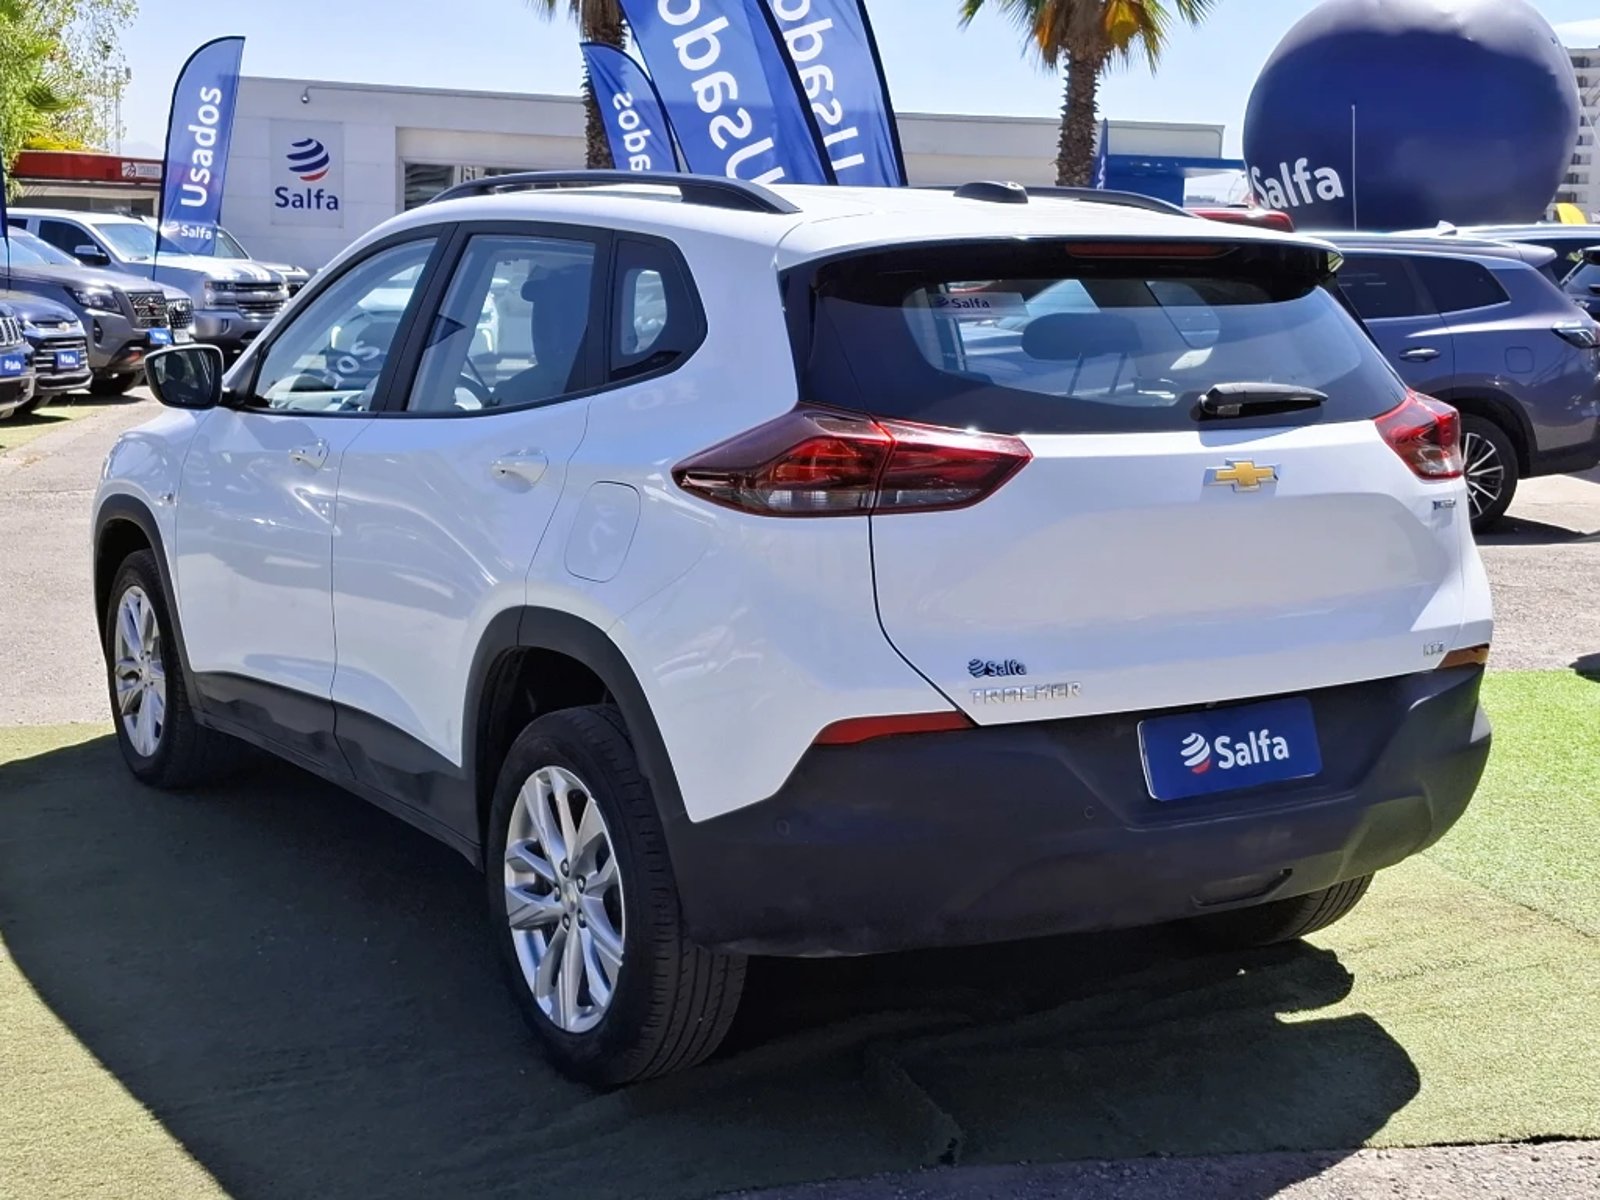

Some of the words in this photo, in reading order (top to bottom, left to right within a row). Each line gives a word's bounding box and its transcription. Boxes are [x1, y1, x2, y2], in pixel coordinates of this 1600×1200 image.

[180, 86, 222, 207] Usados
[1251, 158, 1344, 209] Salfa
[274, 186, 339, 211] Salfa
[180, 224, 213, 240] Salfa
[951, 297, 991, 309] Salfa
[984, 659, 1027, 677] Salfa
[1214, 729, 1290, 769] Salfa
